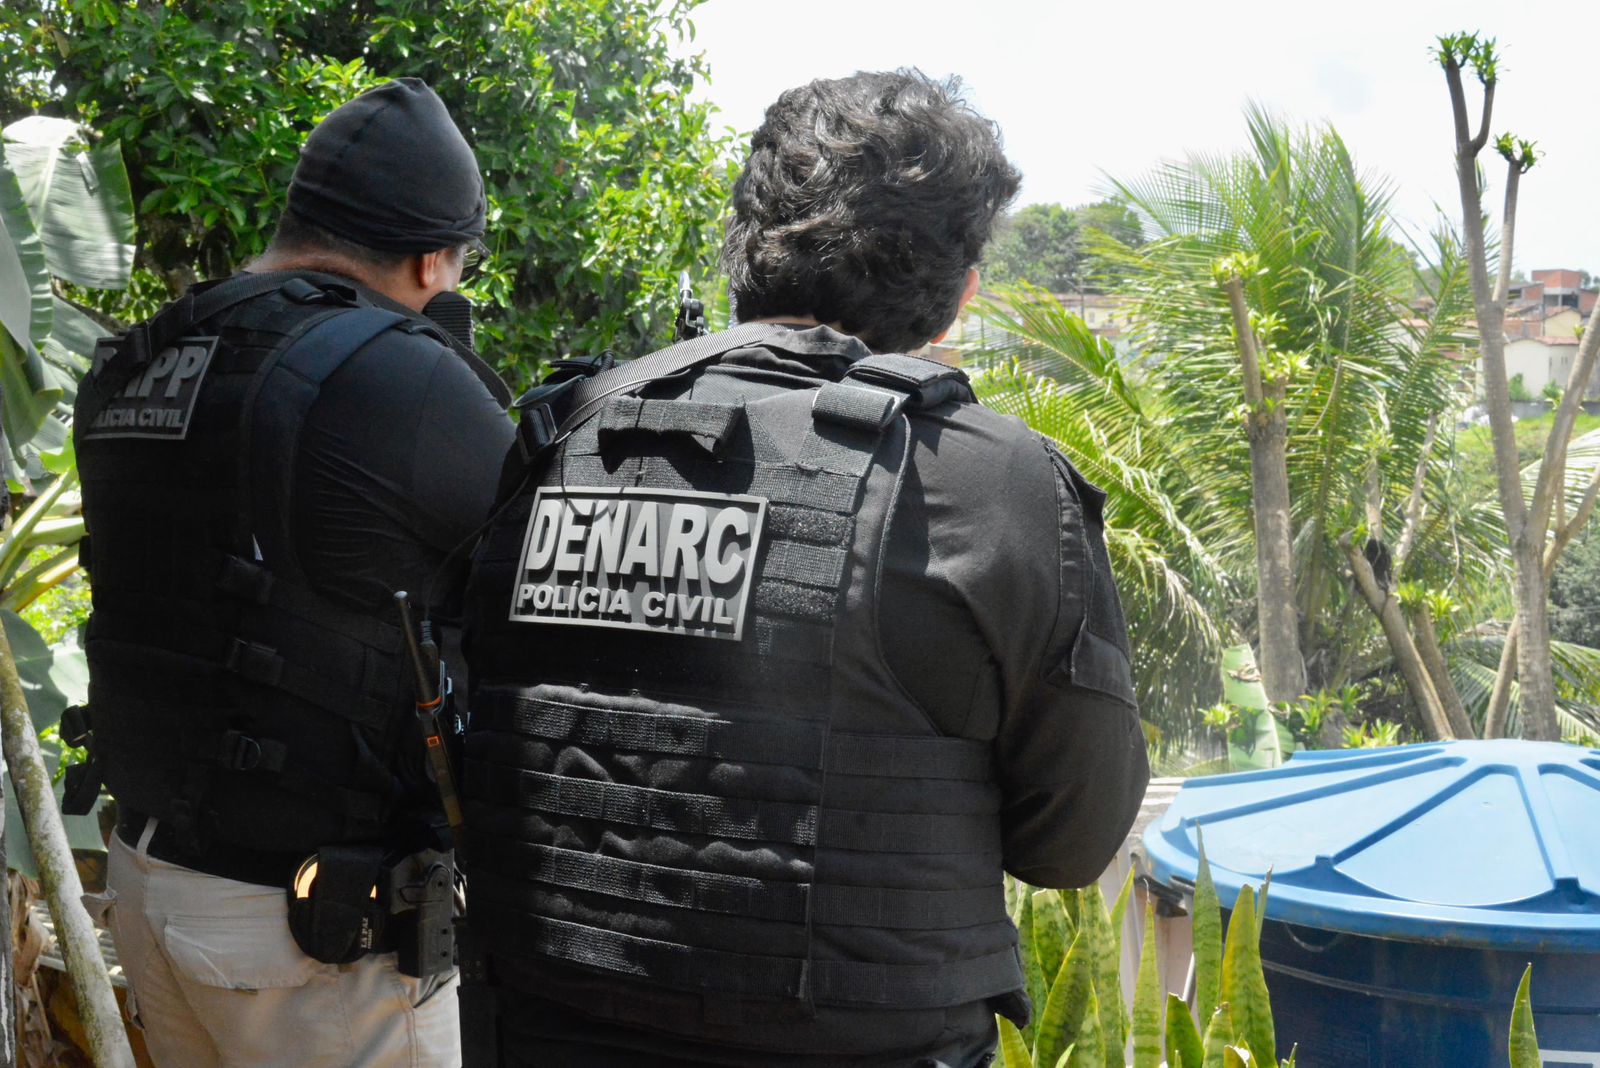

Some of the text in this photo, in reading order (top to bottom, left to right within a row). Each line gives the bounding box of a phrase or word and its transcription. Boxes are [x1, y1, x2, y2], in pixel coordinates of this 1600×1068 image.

[138, 408, 184, 427] CIVIL
[525, 499, 750, 584] DENARC
[516, 580, 734, 625] POLÍCIA CIVIL
